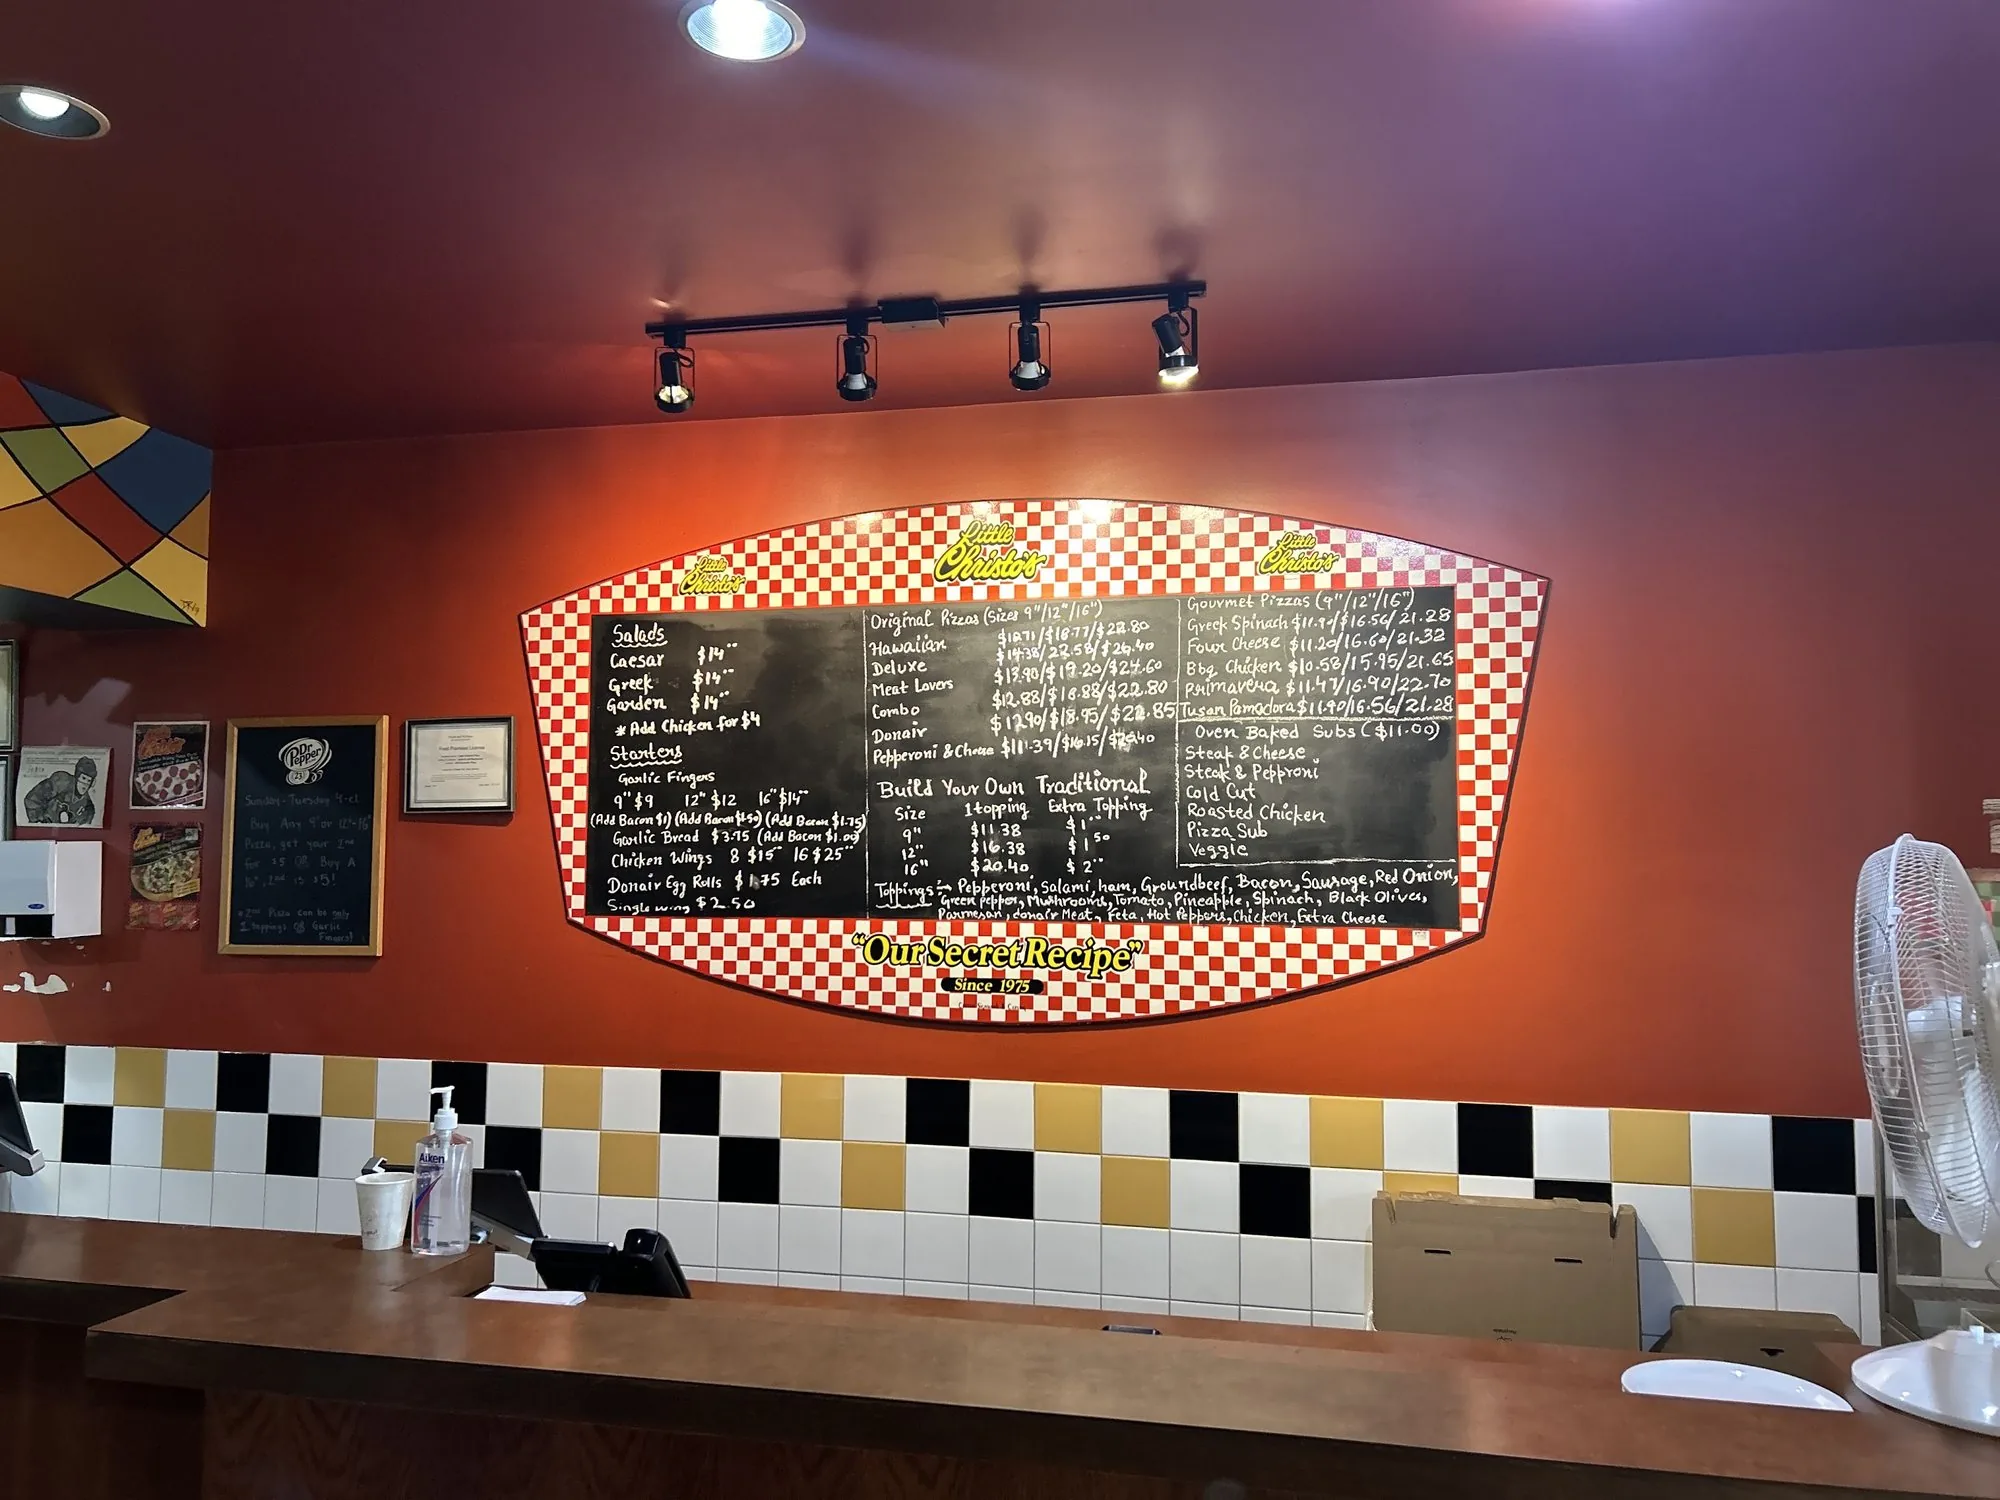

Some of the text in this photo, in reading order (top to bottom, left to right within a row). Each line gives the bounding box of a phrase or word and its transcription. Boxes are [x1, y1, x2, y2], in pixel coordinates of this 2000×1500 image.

[959, 519, 1015, 546] Little
[1277, 531, 1317, 551] Little
[695, 556, 728, 573] Little
[934, 543, 1048, 582] Christo's
[1259, 548, 1341, 574] Christo's
[679, 571, 746, 595] Christo's
[1187, 592, 1311, 615] Gourmet Pizzas
[871, 606, 1019, 637] Original Pizzas (Sizes
[1187, 613, 1289, 636] Greek Spinach
[613, 622, 665, 644] Salads
[869, 634, 947, 657] Hawaiian
[1187, 636, 1281, 655] Four Cheese
[610, 654, 665, 669] Caesar
[871, 661, 928, 677] Deluxe
[1186, 656, 1283, 680] Bbq Chicken
[608, 674, 654, 696] Greek
[872, 678, 954, 697] Meat Lovers
[606, 696, 667, 715] Garden
[872, 704, 920, 720] Combo
[1180, 701, 1227, 718] Tusan
[630, 710, 761, 737] Add Chicken for $4
[872, 720, 928, 745] Donair
[1195, 725, 1239, 740] Oven
[1245, 724, 1300, 745] Baked
[1313, 723, 1356, 739] Subs
[290, 747, 321, 767] Pepper
[300, 743, 313, 756] Dr
[610, 743, 683, 763] Starters
[873, 743, 938, 769] Pepperoni
[1185, 746, 1234, 768] Steak
[1252, 746, 1306, 761] Cheese
[618, 771, 716, 789] Garlic Fingers
[877, 767, 1151, 799] Build Your Own Traditional
[1184, 764, 1232, 783] Steak
[1235, 766, 1247, 780] &
[288, 793, 330, 807] Tuesday
[634, 791, 654, 811] $9
[711, 789, 737, 811] $12
[1186, 783, 1256, 802] Cold Cut
[894, 795, 1154, 822] Size Extra Topping
[1187, 802, 1326, 826] Roasted Chicken
[251, 816, 270, 834] Buy
[590, 812, 616, 829] (Add
[619, 813, 654, 826] Bacon
[656, 811, 672, 830] $1)
[675, 811, 702, 828] (Add
[766, 811, 793, 829] (Add
[1187, 821, 1268, 839] Pizza Sub
[613, 829, 656, 847] Garlic
[661, 830, 699, 845] Bread
[711, 828, 750, 845] $3.75
[757, 828, 784, 846] (Add
[788, 831, 822, 843] Bacon
[970, 838, 1026, 857] $16.38
[611, 847, 809, 870] Chicken Wings 8 16
[1189, 838, 1249, 860] Veggie
[320, 855, 340, 871] Buy
[347, 857, 356, 868] A
[970, 857, 1030, 878] $20.40
[607, 871, 822, 898] Donair Egg Rolls Each
[1236, 873, 1301, 892] Bacon,
[1301, 870, 1375, 894] Sausage,
[1375, 868, 1398, 884] Red
[1403, 863, 1459, 888] Onion,
[607, 900, 651, 916] Single
[696, 896, 756, 910] $2.50
[940, 894, 976, 910] Green
[1253, 891, 1323, 909] Spinach,
[1329, 890, 1371, 906] Black
[1147, 909, 1171, 922] Hot
[1233, 909, 1296, 927] Chicken,
[1298, 908, 1336, 924] Extra
[1341, 911, 1388, 924] Cheese
[927, 935, 1021, 968] Secret
[954, 977, 1031, 994] Since 1975
[419, 1152, 445, 1164] Aiken
